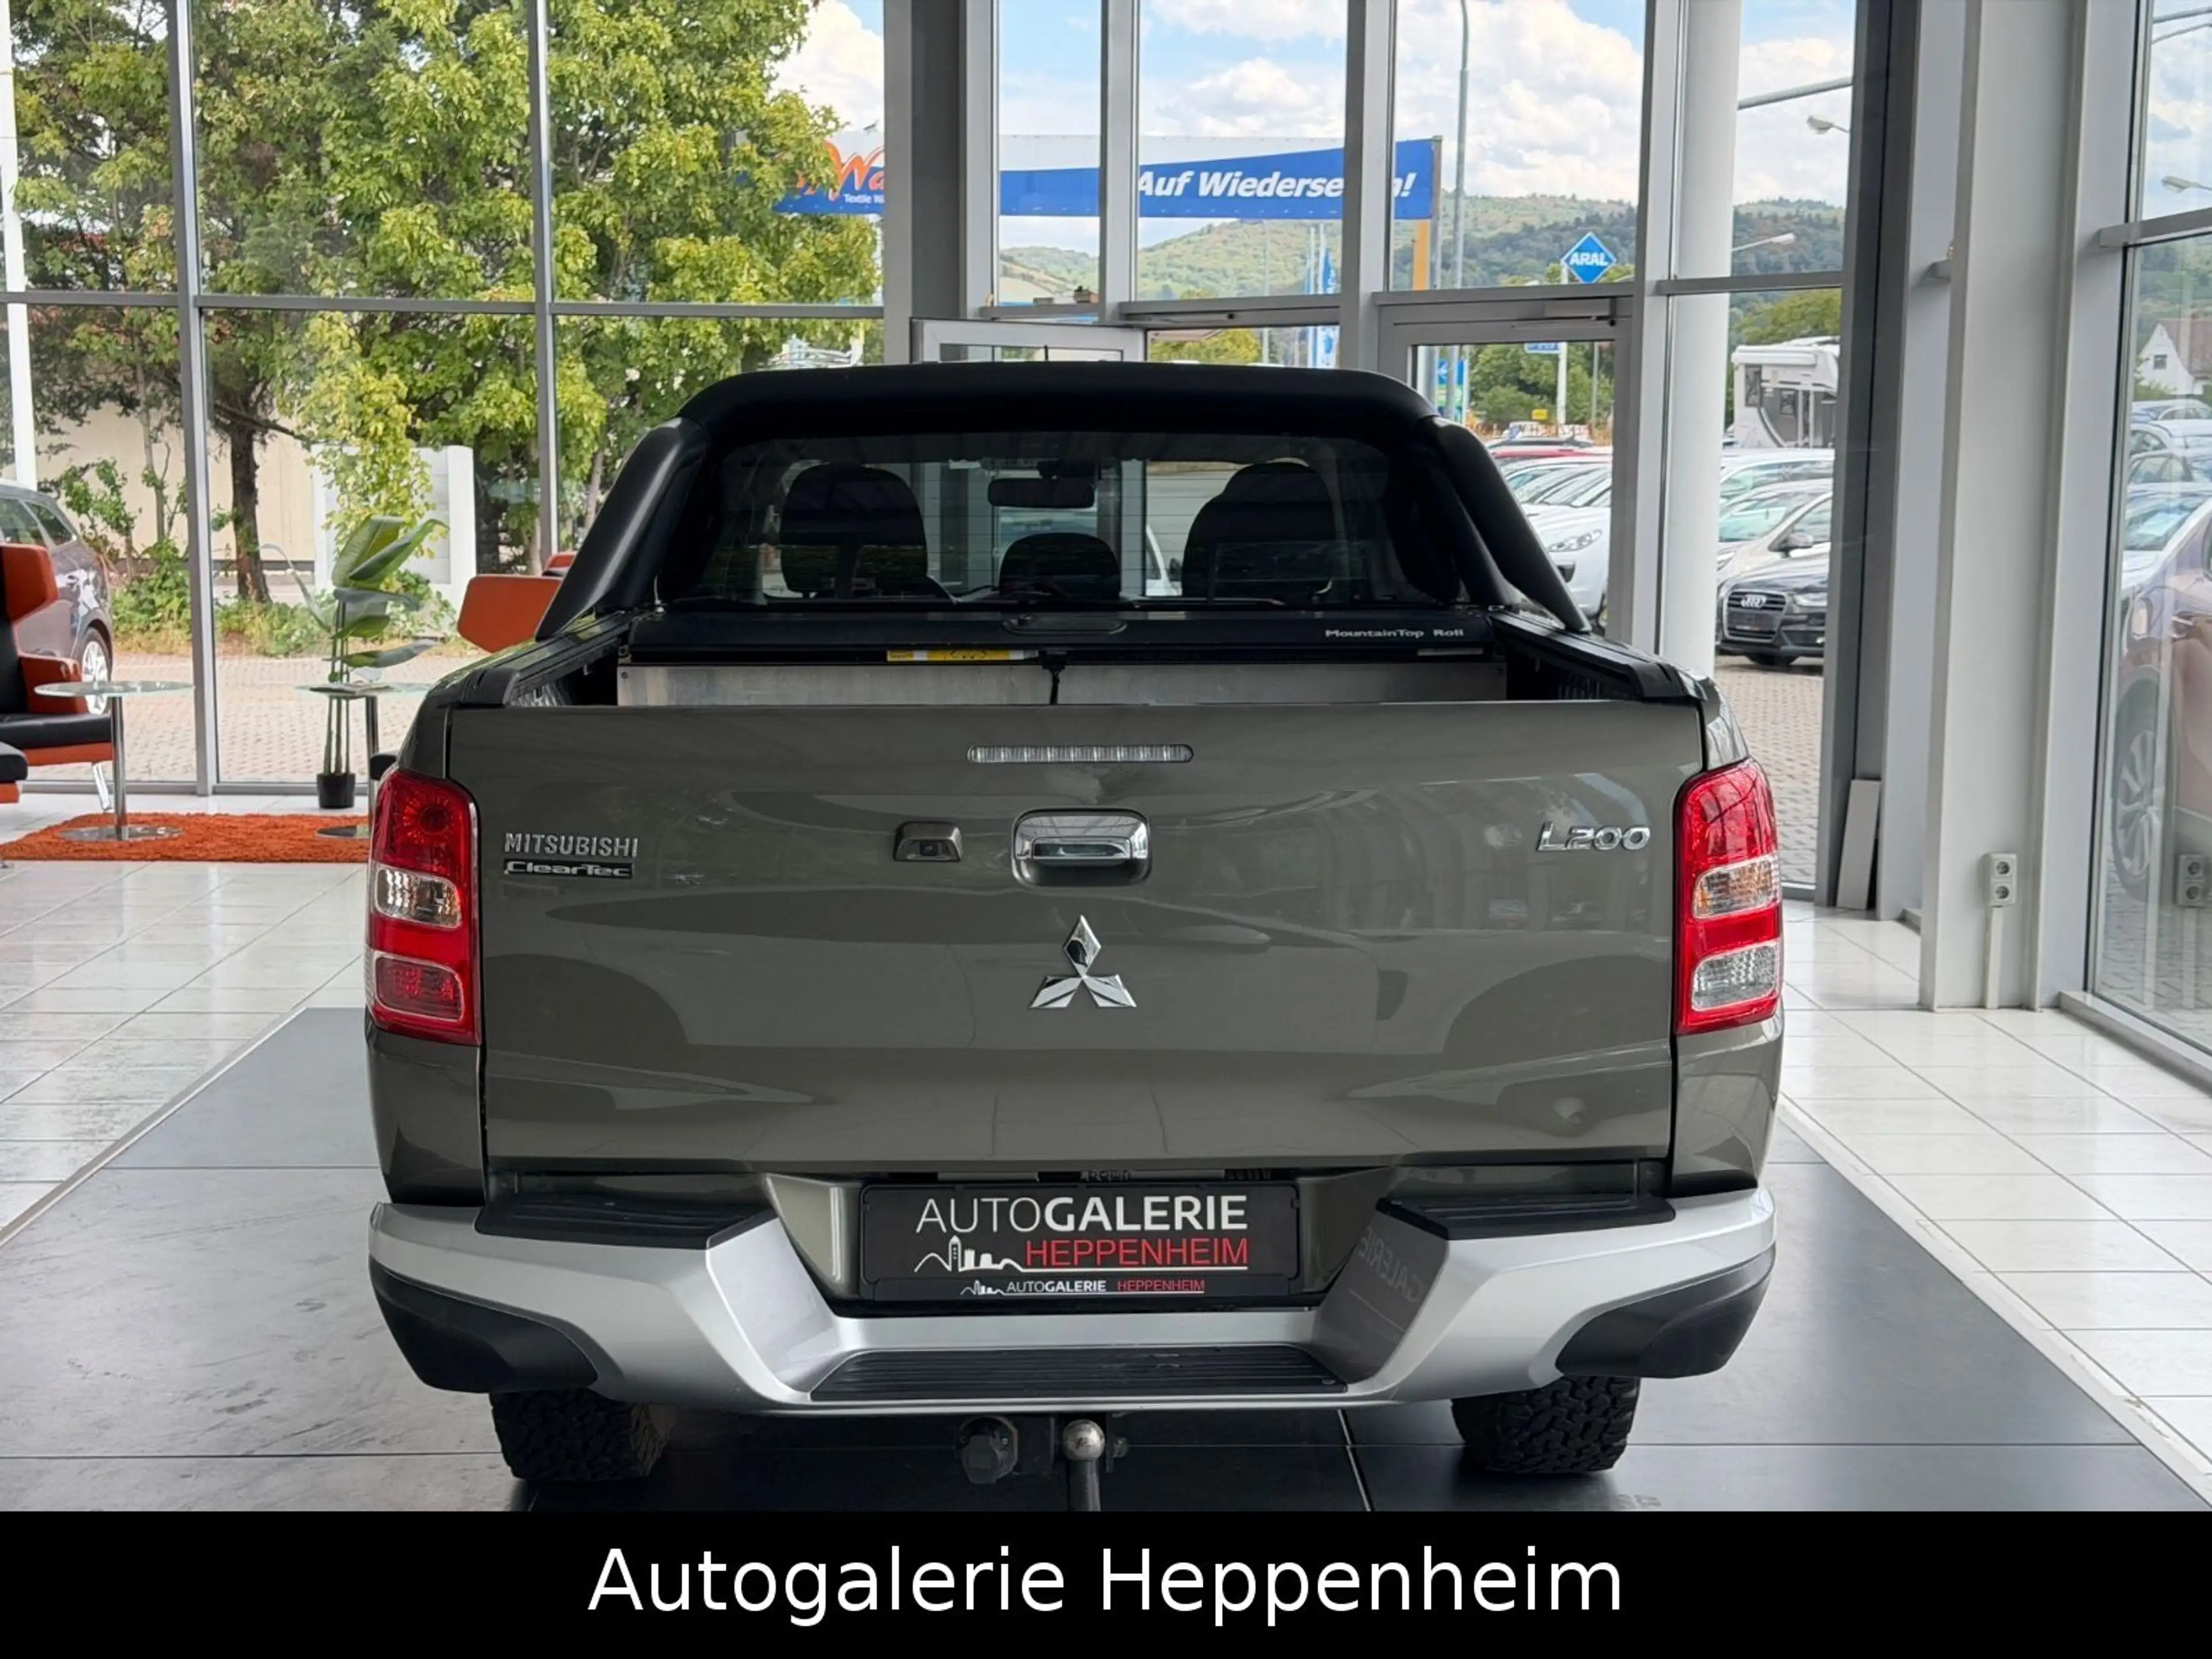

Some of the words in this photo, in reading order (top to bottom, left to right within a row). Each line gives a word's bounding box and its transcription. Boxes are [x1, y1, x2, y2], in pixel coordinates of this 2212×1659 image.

[1138, 171, 1194, 197] Auf
[1569, 251, 1609, 266] ARAL
[1325, 629, 1425, 638] MountainTop
[505, 832, 639, 858] MITSUBISHI
[1537, 821, 1650, 851] L200
[506, 861, 631, 876] ClearTec
[916, 1195, 1248, 1233] AUTOGALERIE
[1025, 1237, 1249, 1267] HEPPENHEIM
[1006, 1279, 1108, 1292] AUTOGALERIE
[1117, 1279, 1205, 1291] HEPPENHEIM
